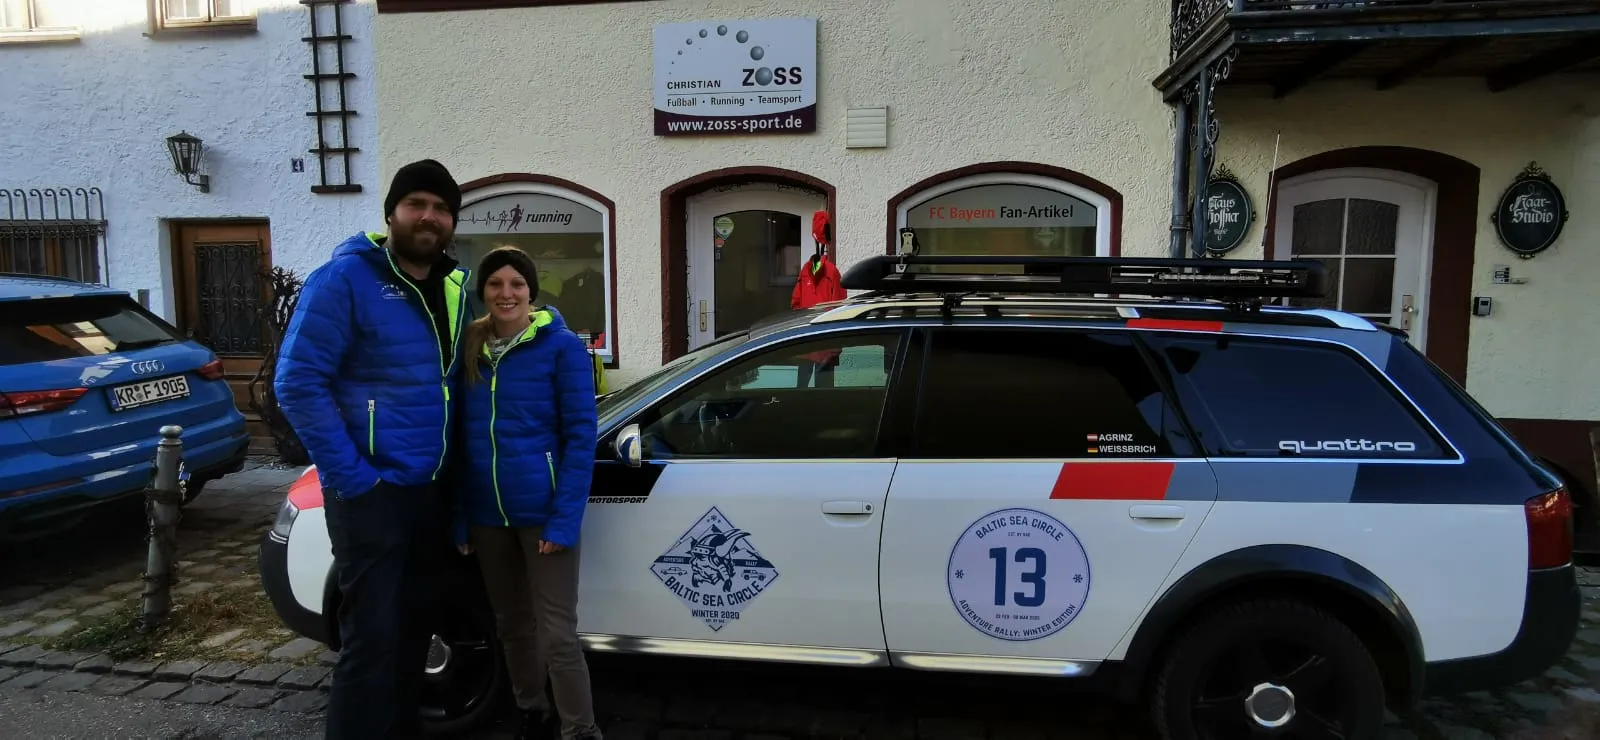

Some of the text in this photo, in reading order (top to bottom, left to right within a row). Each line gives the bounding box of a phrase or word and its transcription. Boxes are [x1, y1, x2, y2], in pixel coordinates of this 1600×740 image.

[667, 80, 721, 90] CHRISTIAN
[667, 94, 802, 107] Fußball Running Teamsport
[667, 116, 802, 134] www.zoss-sport.de
[1509, 194, 1551, 212] Haar-
[525, 210, 573, 226] running
[929, 205, 1074, 222] FC Bayern Fan-Artikel
[1511, 208, 1553, 223] Studio
[116, 378, 186, 405] KR F 1905
[1099, 433, 1133, 442] AGRINZ
[1099, 445, 1156, 453] WEISSBRICH
[1278, 438, 1416, 454] quattro
[975, 516, 1064, 542] BALTIC SEA CIRCLE
[989, 547, 1047, 607] 13
[664, 576, 763, 607] BALTIC SEA CIRCLE
[692, 609, 740, 620] WINTER 2020
[959, 599, 993, 631] ADVENTURE
[1023, 623, 1052, 637] WINTER
[1053, 604, 1076, 627] EDITION
